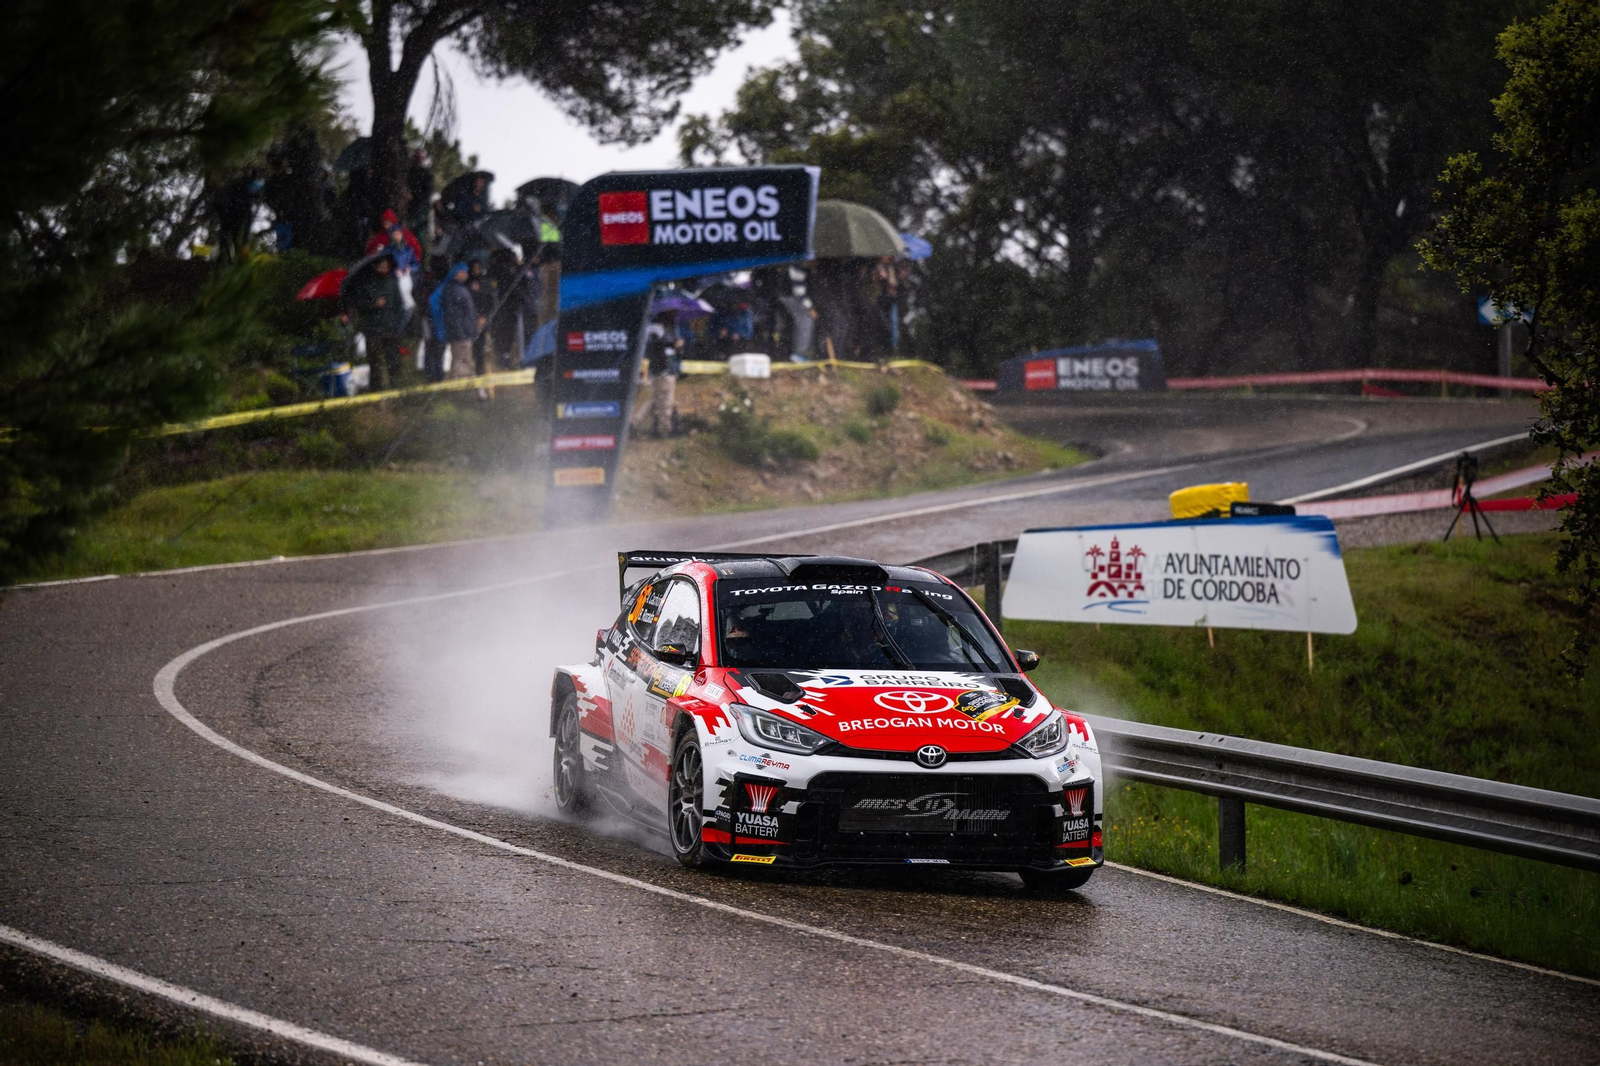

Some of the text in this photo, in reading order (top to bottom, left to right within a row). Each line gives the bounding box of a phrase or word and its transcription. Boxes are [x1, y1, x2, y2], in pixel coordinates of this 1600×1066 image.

[651, 185, 781, 221] ENEOS
[603, 211, 645, 225] ENEOS
[654, 220, 782, 244] MOTOR OIL
[1057, 357, 1138, 377] ENEOS
[1058, 377, 1111, 390] MOTOR
[1164, 552, 1301, 580] AYUNTAMIENTO
[730, 585, 808, 597] TOYOTA
[886, 586, 953, 600] Raing
[830, 588, 864, 596] Spain
[1163, 573, 1280, 604] DE CÓRDOBA
[859, 674, 941, 682] GRUPO
[864, 679, 980, 689] BARREIRO
[838, 717, 1006, 735] BREOGAN MOTOR
[739, 754, 790, 770] CLIMAREYMA
[736, 812, 779, 827] YUASA
[1063, 818, 1090, 832] YUASA
[735, 822, 779, 838] BATTERY
